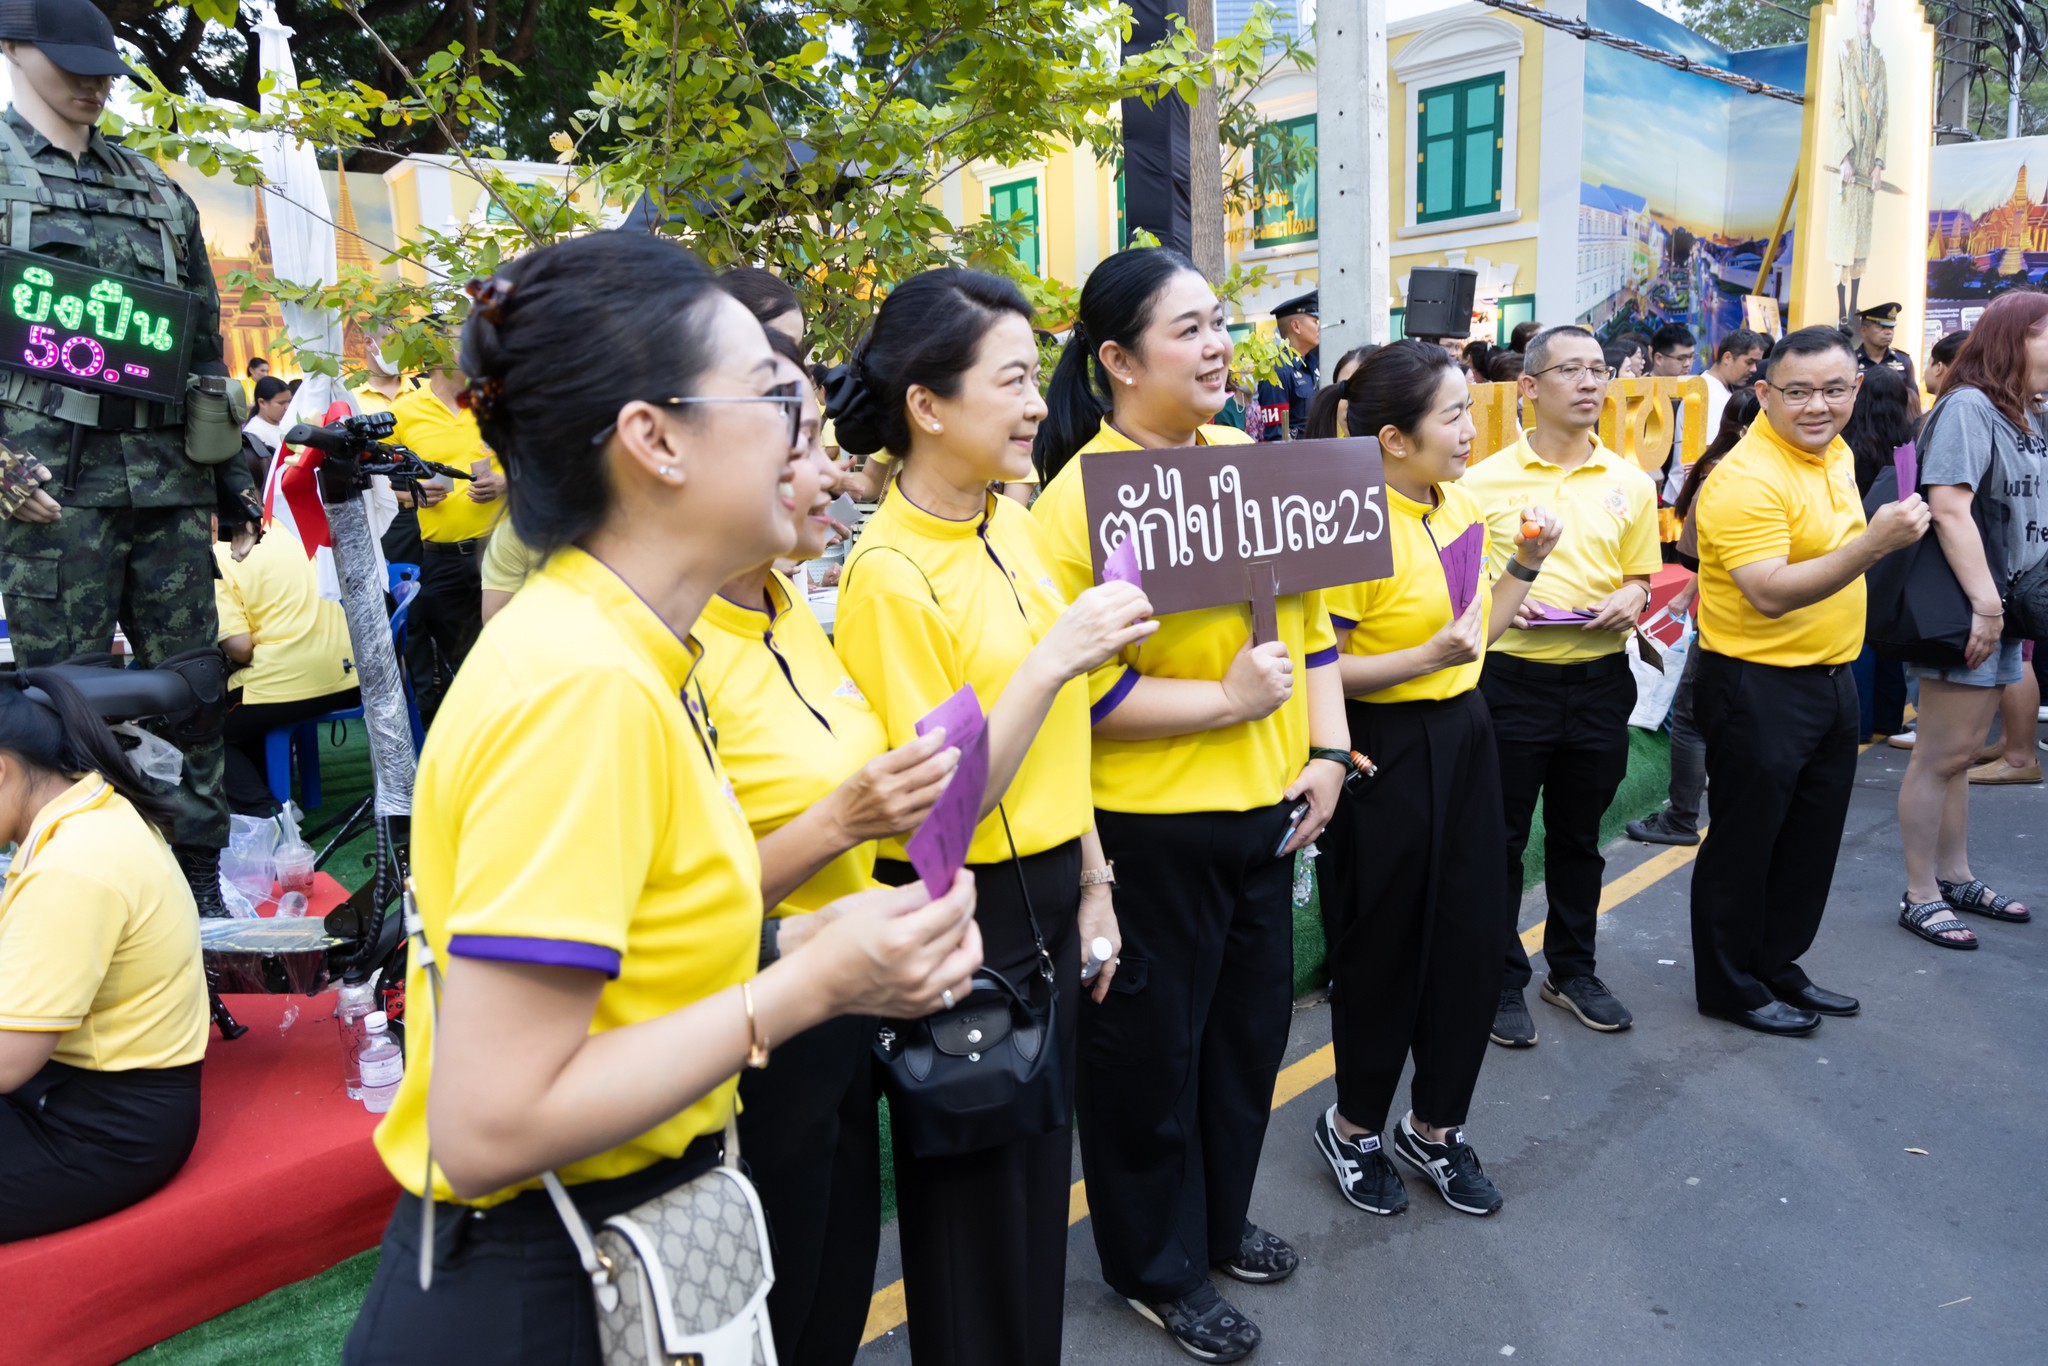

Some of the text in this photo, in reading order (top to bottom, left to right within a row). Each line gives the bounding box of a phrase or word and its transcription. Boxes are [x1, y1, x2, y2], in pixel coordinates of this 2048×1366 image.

[12, 266, 173, 351] ยิงปืน
[24, 325, 150, 383] 50.-
[2003, 474, 2048, 499] wit
